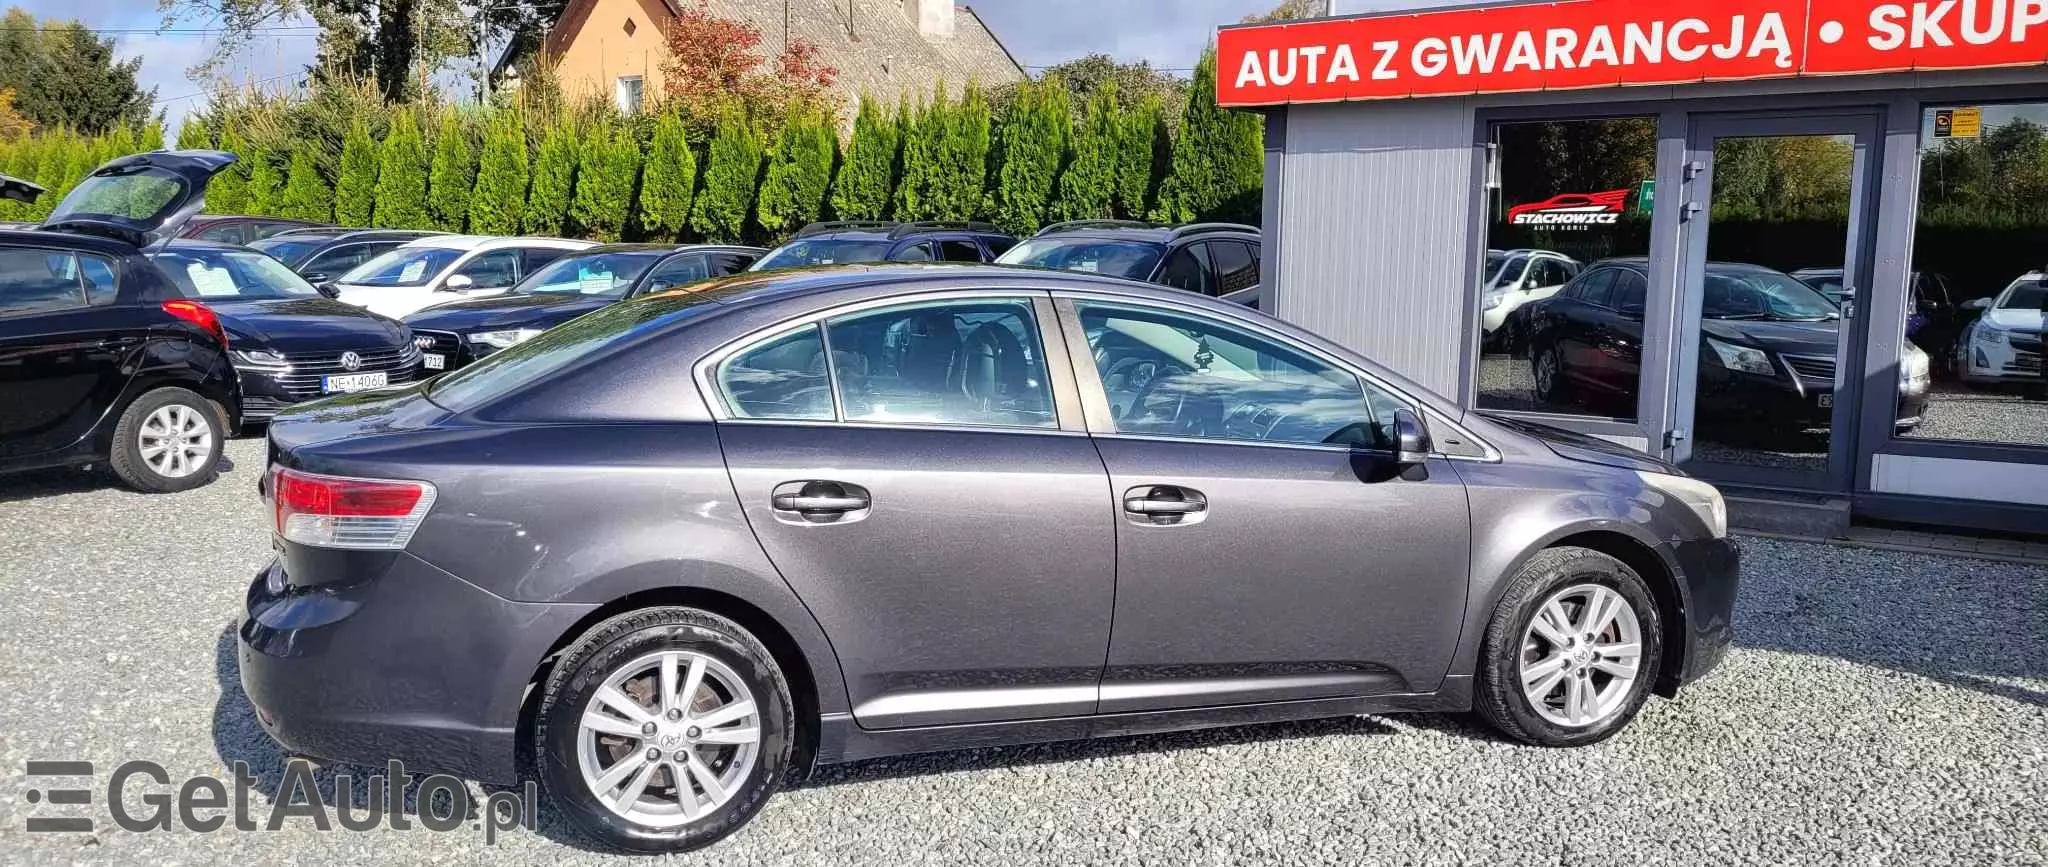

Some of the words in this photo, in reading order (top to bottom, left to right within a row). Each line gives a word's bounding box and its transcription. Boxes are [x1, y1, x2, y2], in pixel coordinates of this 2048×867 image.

[1234, 44, 1360, 89] AUTA
[1372, 41, 1400, 81] Z
[1411, 12, 1793, 77] GWARANCJĄ
[1512, 213, 1619, 224] STACHOWICZ
